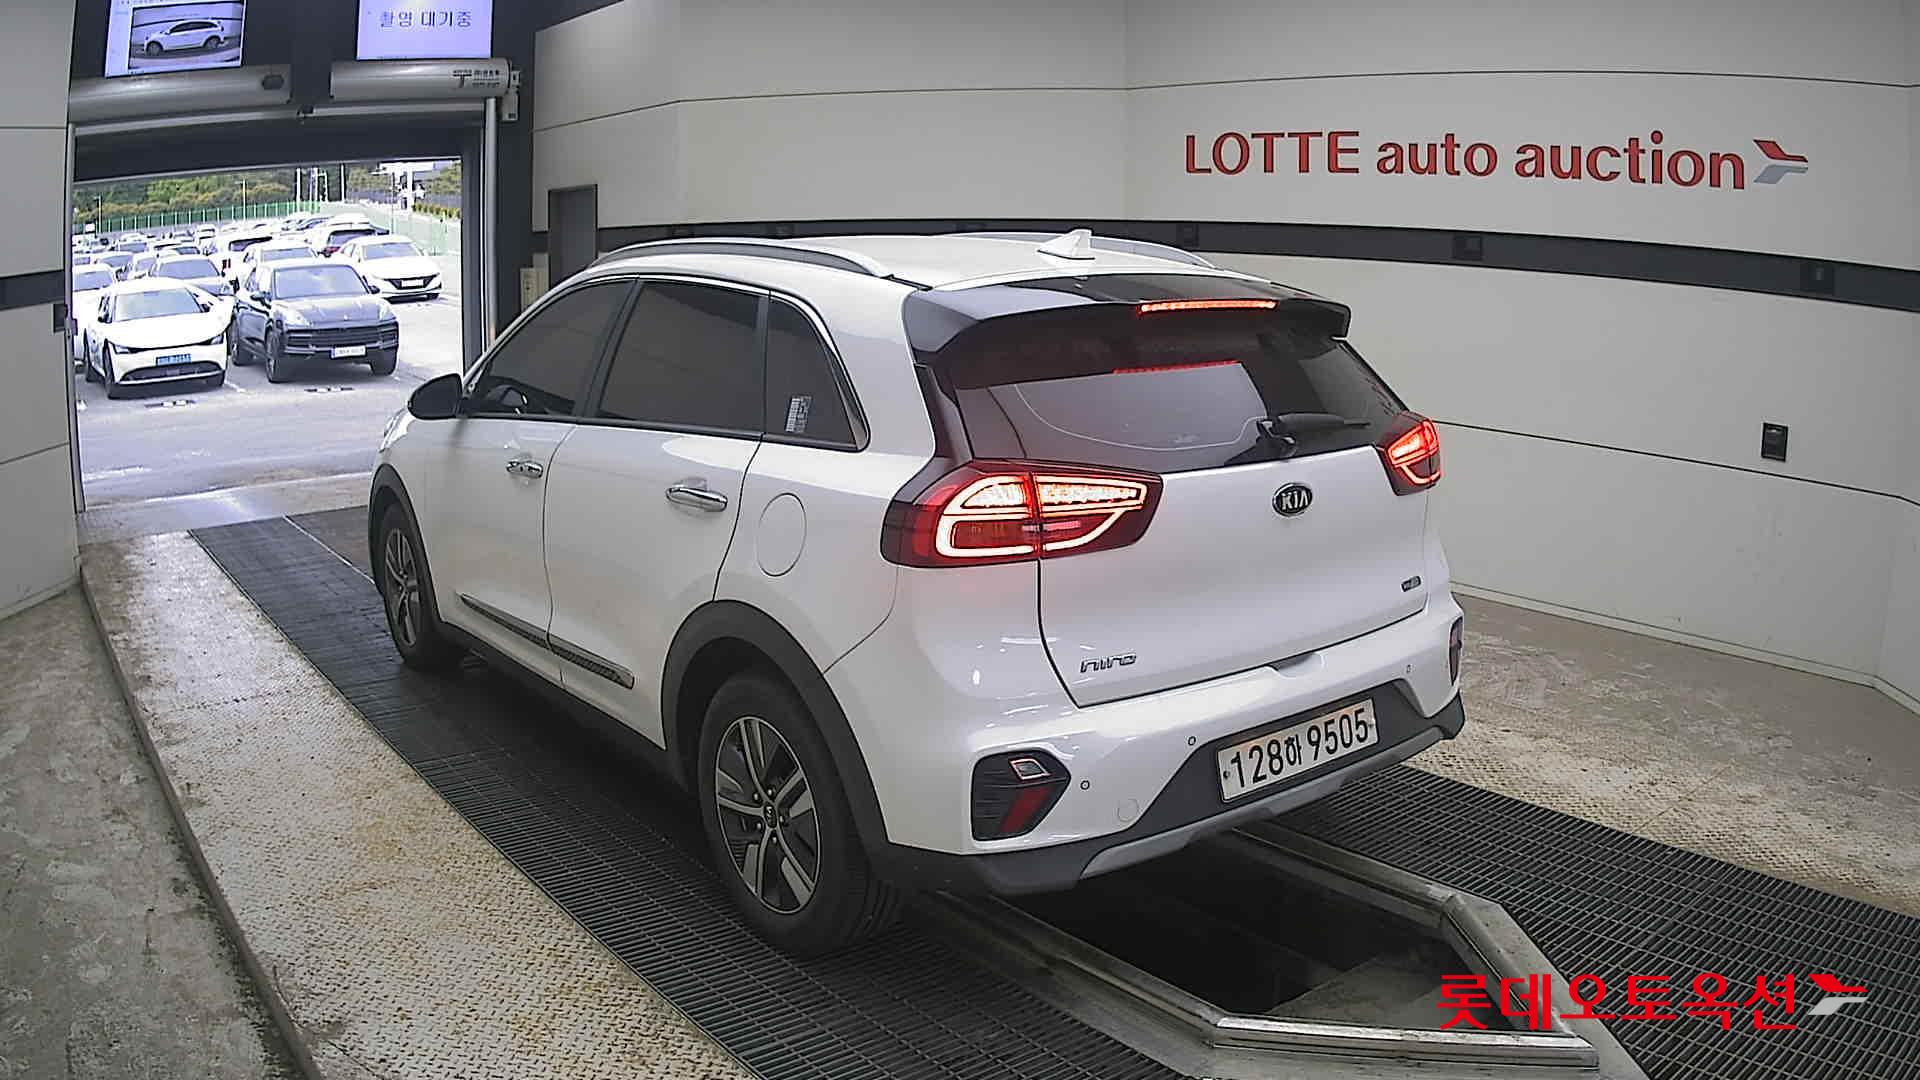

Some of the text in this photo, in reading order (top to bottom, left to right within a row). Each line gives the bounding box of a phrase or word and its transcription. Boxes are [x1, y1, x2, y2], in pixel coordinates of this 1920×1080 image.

[420, 11, 472, 28] 대기중
[1185, 131, 1746, 189] LOTTE auto auction
[1230, 707, 1369, 788] 128하 9505
